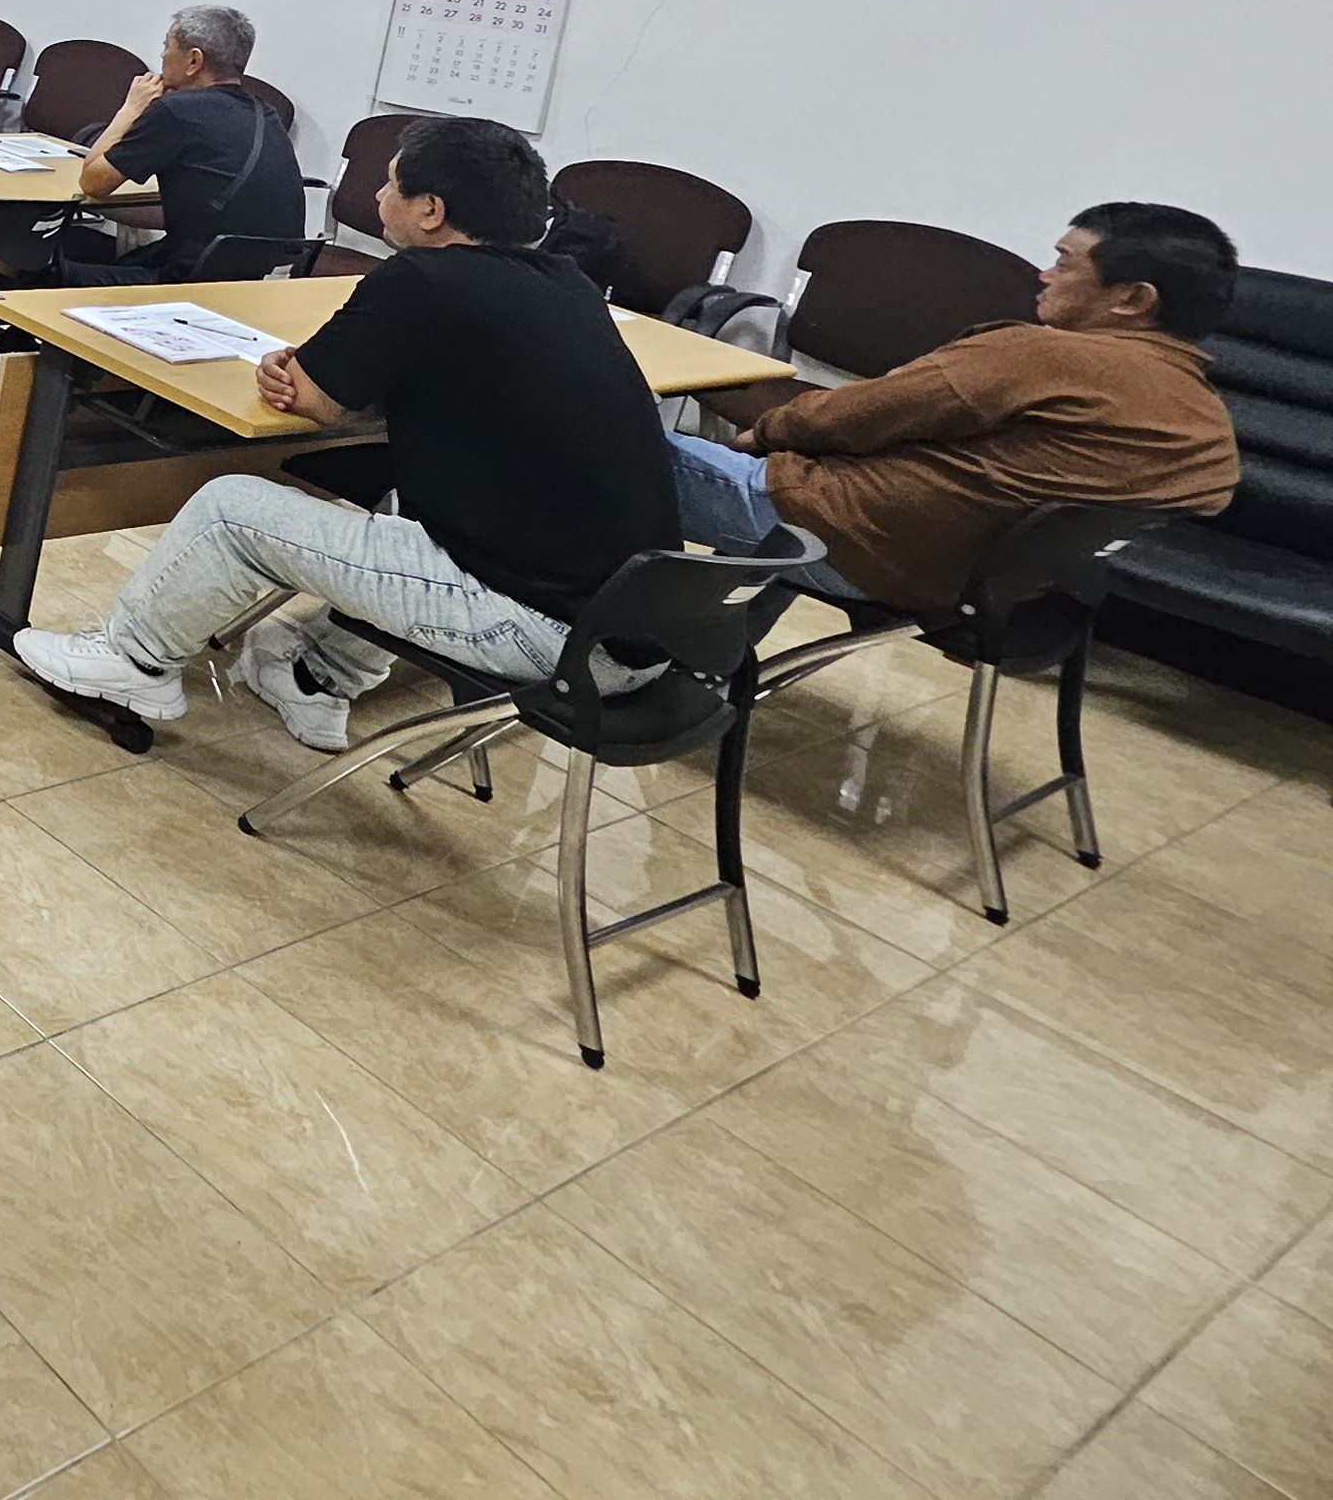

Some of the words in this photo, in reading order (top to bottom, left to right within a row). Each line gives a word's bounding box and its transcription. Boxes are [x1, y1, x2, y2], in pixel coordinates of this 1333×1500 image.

[495, 1, 507, 10] 22
[515, 5, 527, 14] 23
[538, 8, 551, 18] 24
[402, 4, 411, 12] 25
[420, 6, 432, 15] 26
[444, 9, 458, 18] 27
[469, 13, 482, 22] 28
[492, 17, 503, 26] 29
[511, 20, 524, 30] 30
[535, 24, 547, 34] 31
[397, 26, 405, 35] 11
[450, 70, 460, 78] 24
